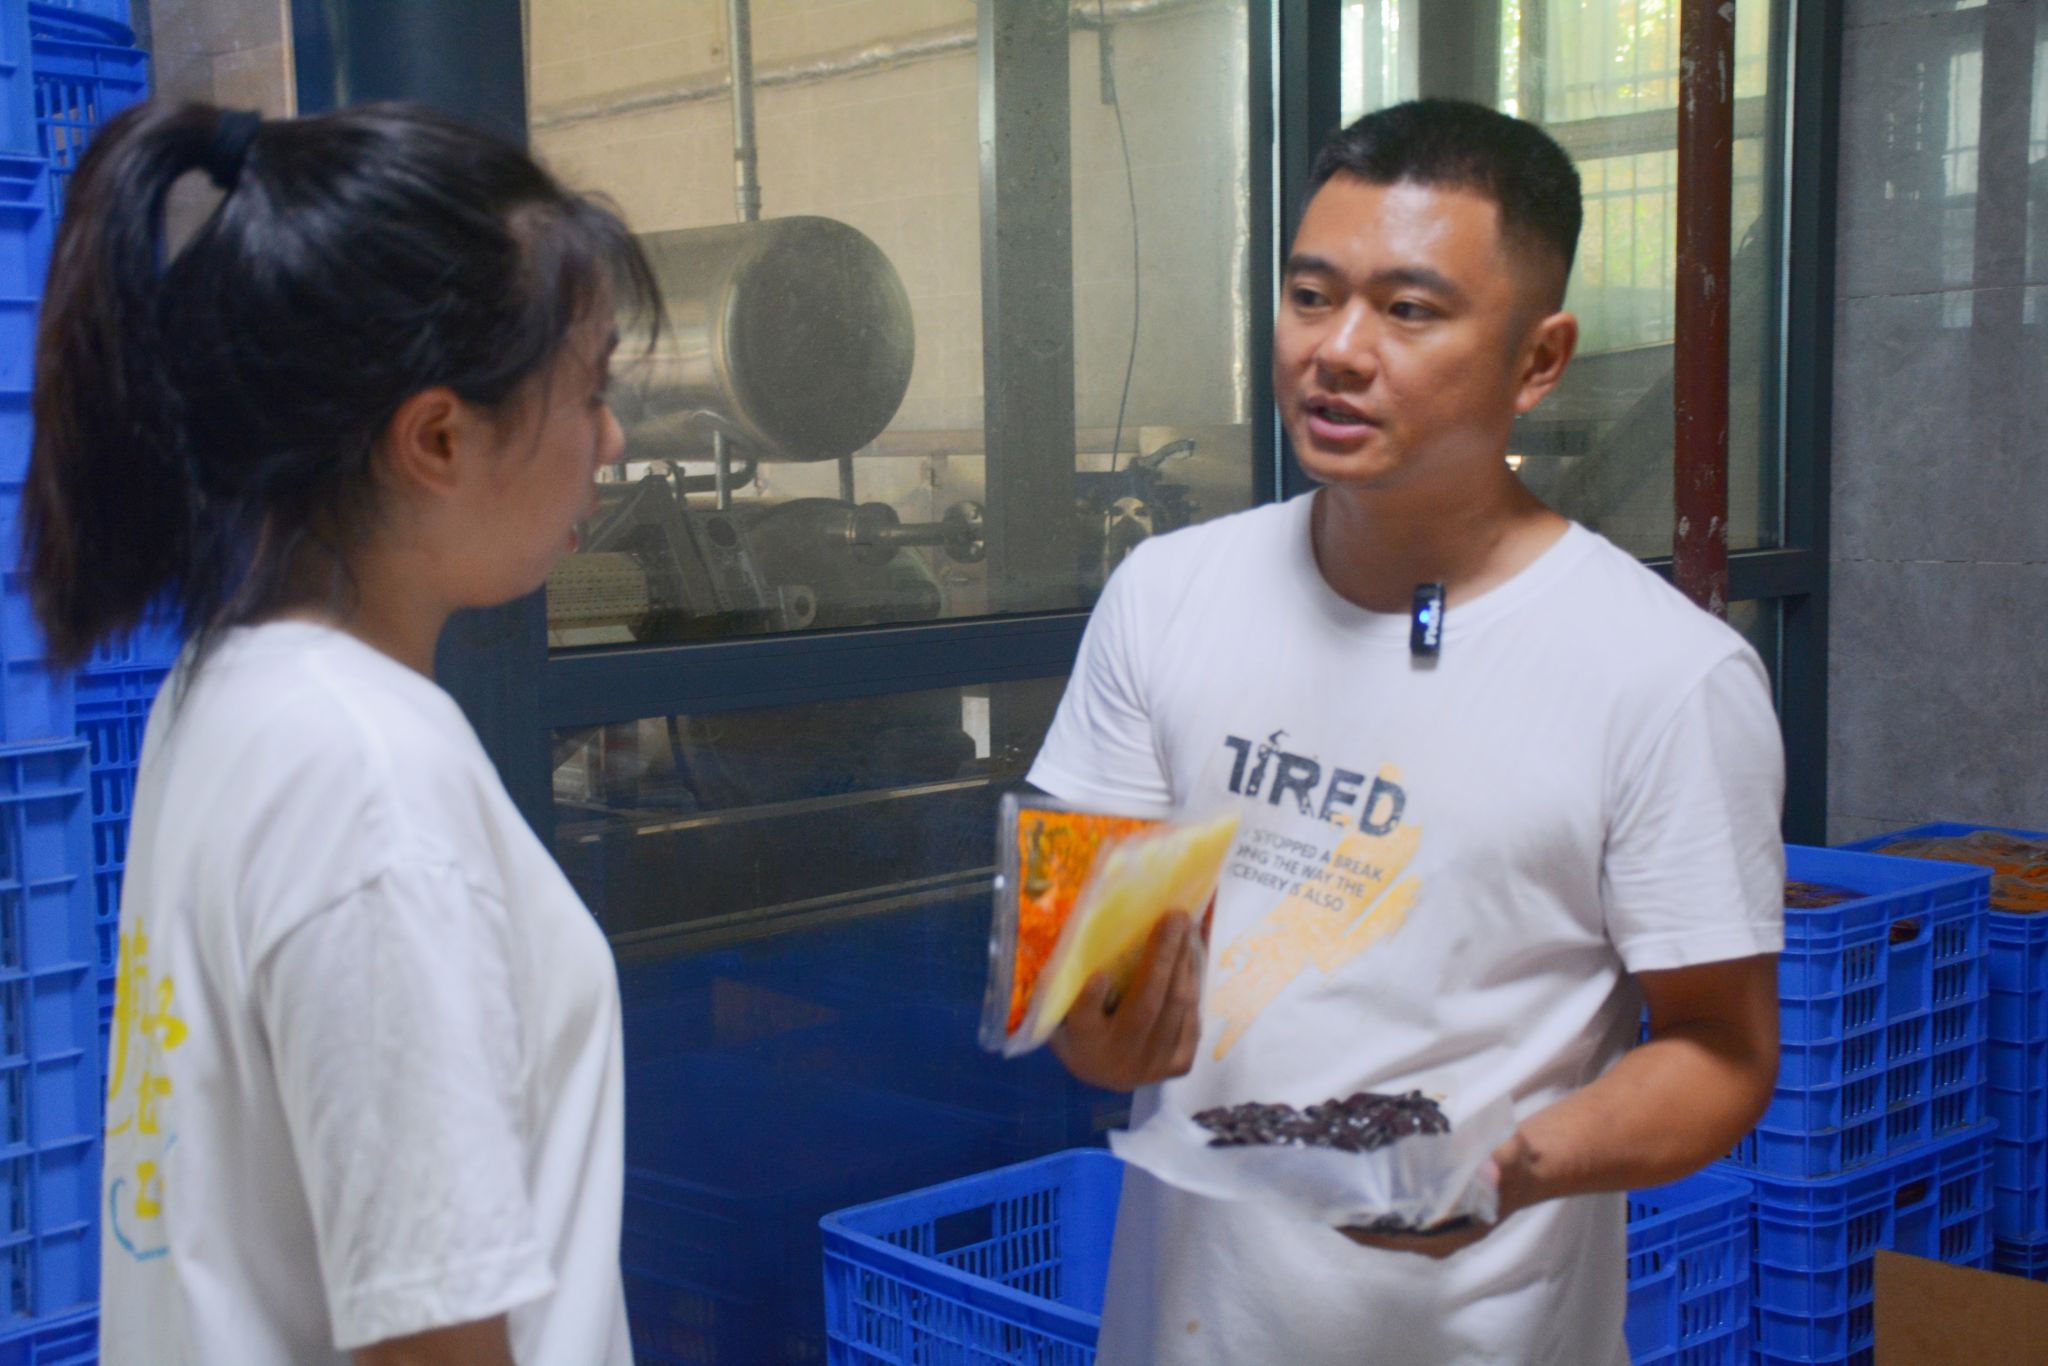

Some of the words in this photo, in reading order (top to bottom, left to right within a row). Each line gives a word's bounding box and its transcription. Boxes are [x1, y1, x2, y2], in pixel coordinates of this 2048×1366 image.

[1224, 734, 1407, 838] TIRED
[1231, 863, 1289, 892] CENERY
[1304, 888, 1345, 912] ALSO
[1274, 855, 1301, 876] THE
[1301, 864, 1333, 884] WAY
[1338, 876, 1366, 898] THE
[1320, 850, 1331, 865] A
[1334, 855, 1384, 882] BREAK
